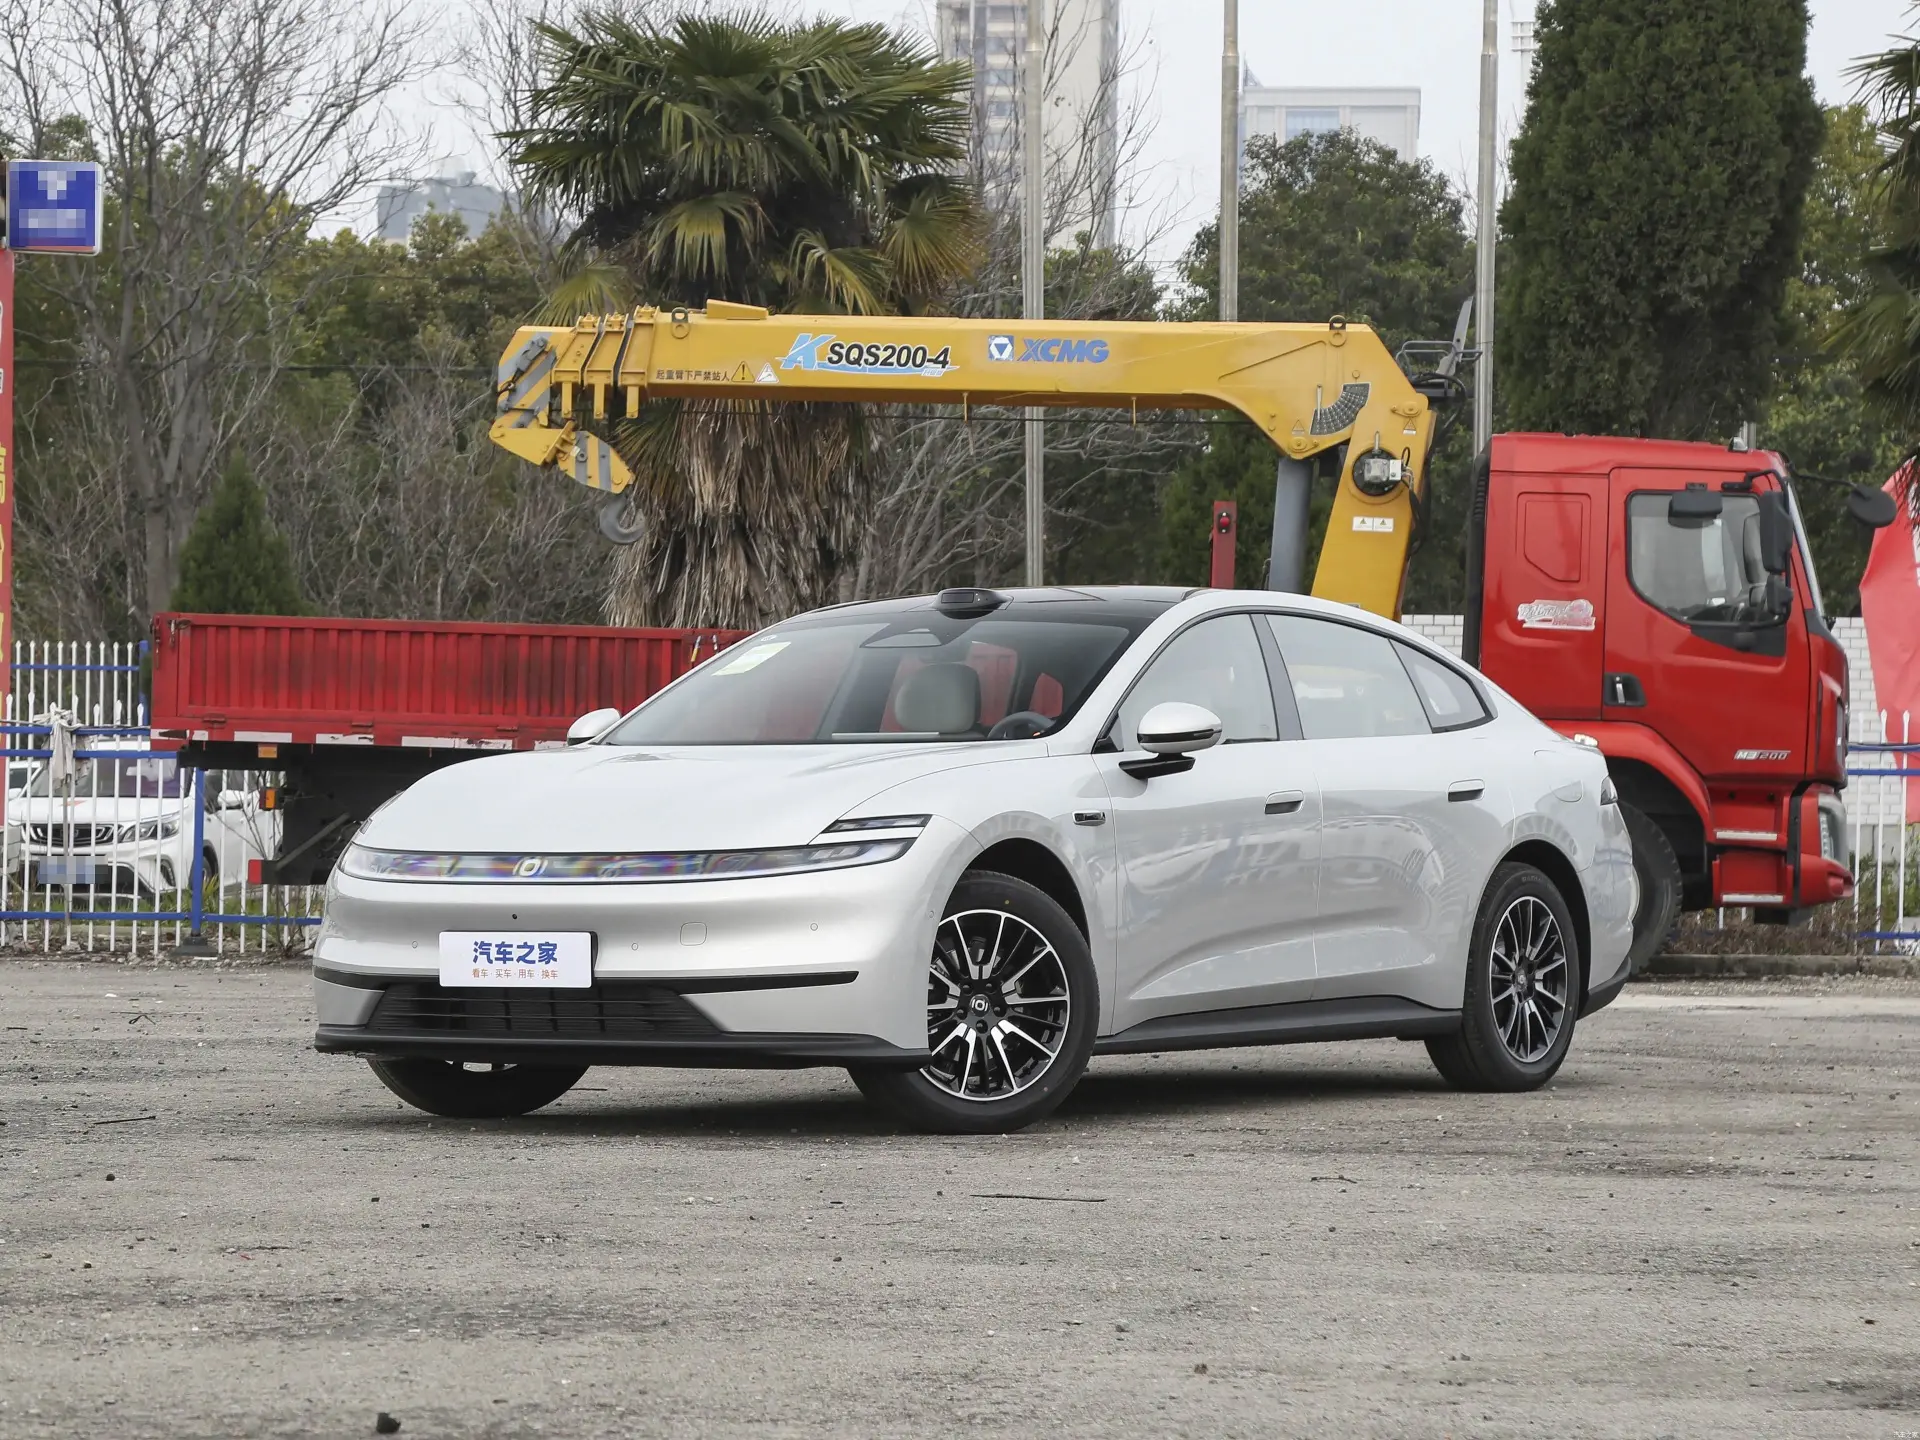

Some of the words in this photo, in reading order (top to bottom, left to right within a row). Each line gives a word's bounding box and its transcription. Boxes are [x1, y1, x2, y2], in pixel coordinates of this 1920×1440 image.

[827, 342, 950, 369] SQS200-4
[1017, 338, 1110, 363] XCMG
[656, 369, 730, 382] 起重臂下严禁站人
[472, 940, 558, 965] 汽车之家
